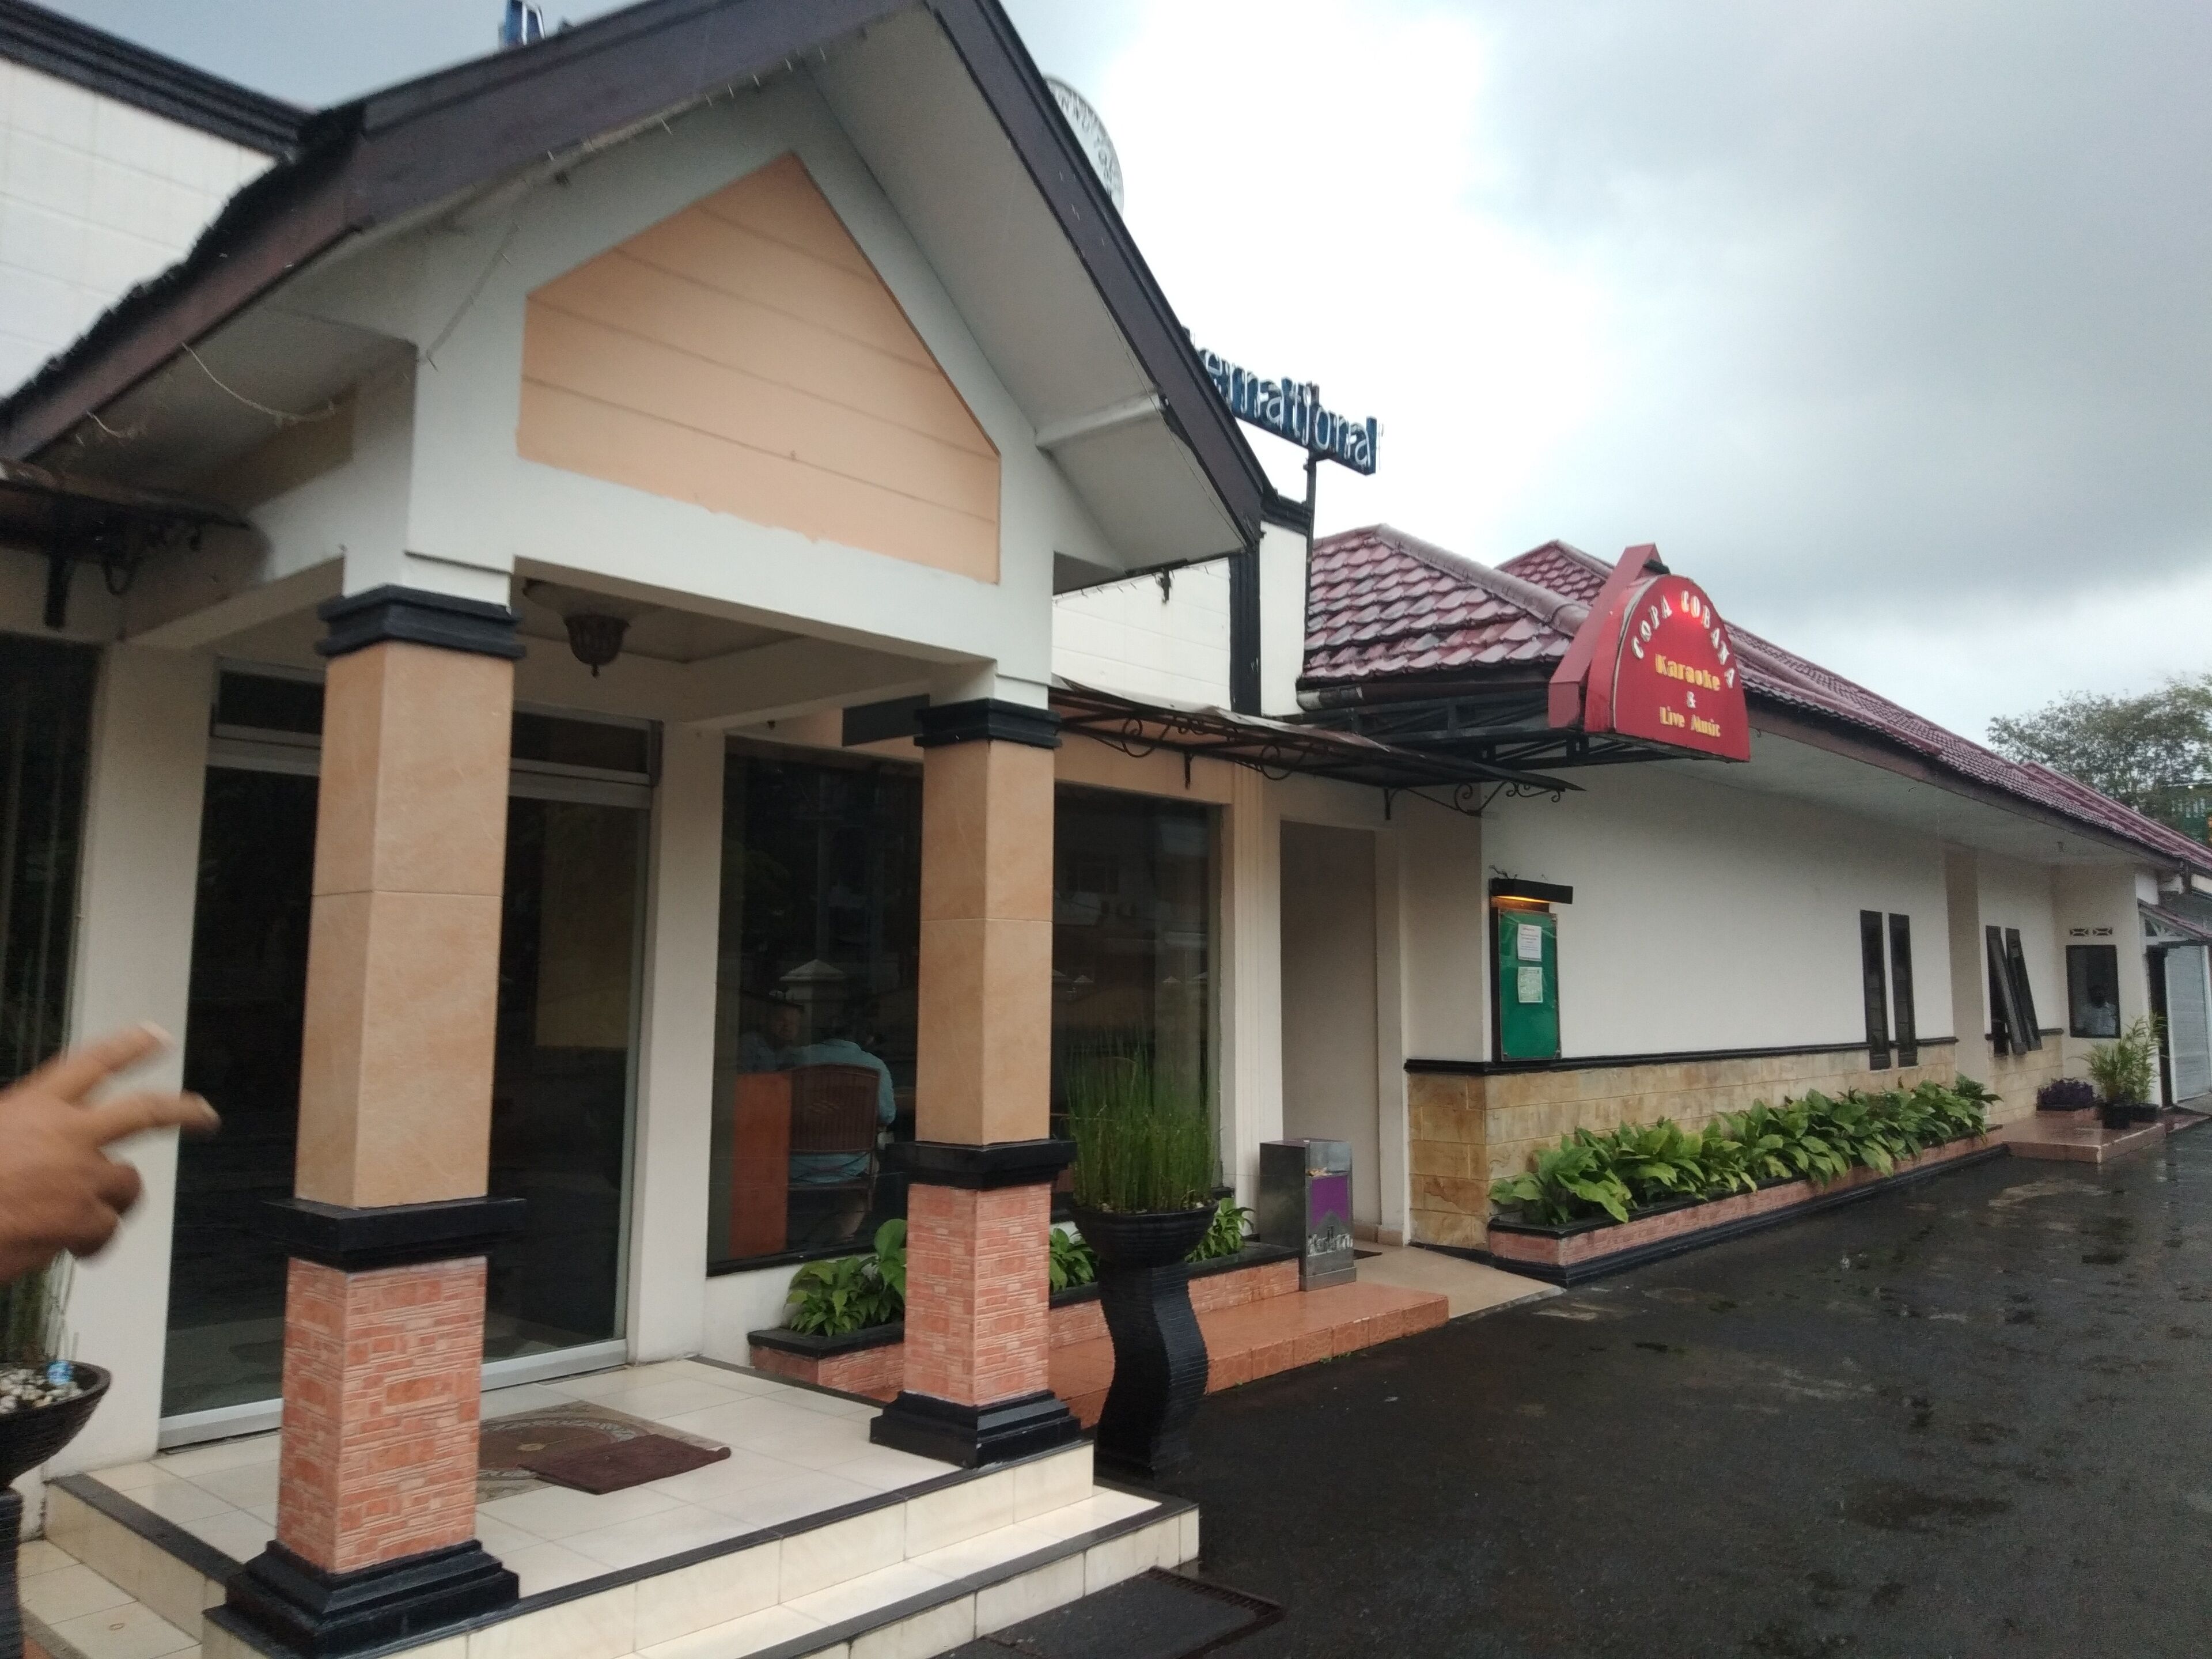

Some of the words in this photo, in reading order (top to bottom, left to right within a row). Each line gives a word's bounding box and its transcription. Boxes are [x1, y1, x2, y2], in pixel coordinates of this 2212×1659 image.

[1191, 339, 1382, 475] ernational
[1631, 594, 1672, 659] COPA
[1655, 654, 1720, 691] Karaoke
[1687, 691, 1696, 709] &
[1660, 706, 1685, 728] Live
[1690, 714, 1721, 737] Music
